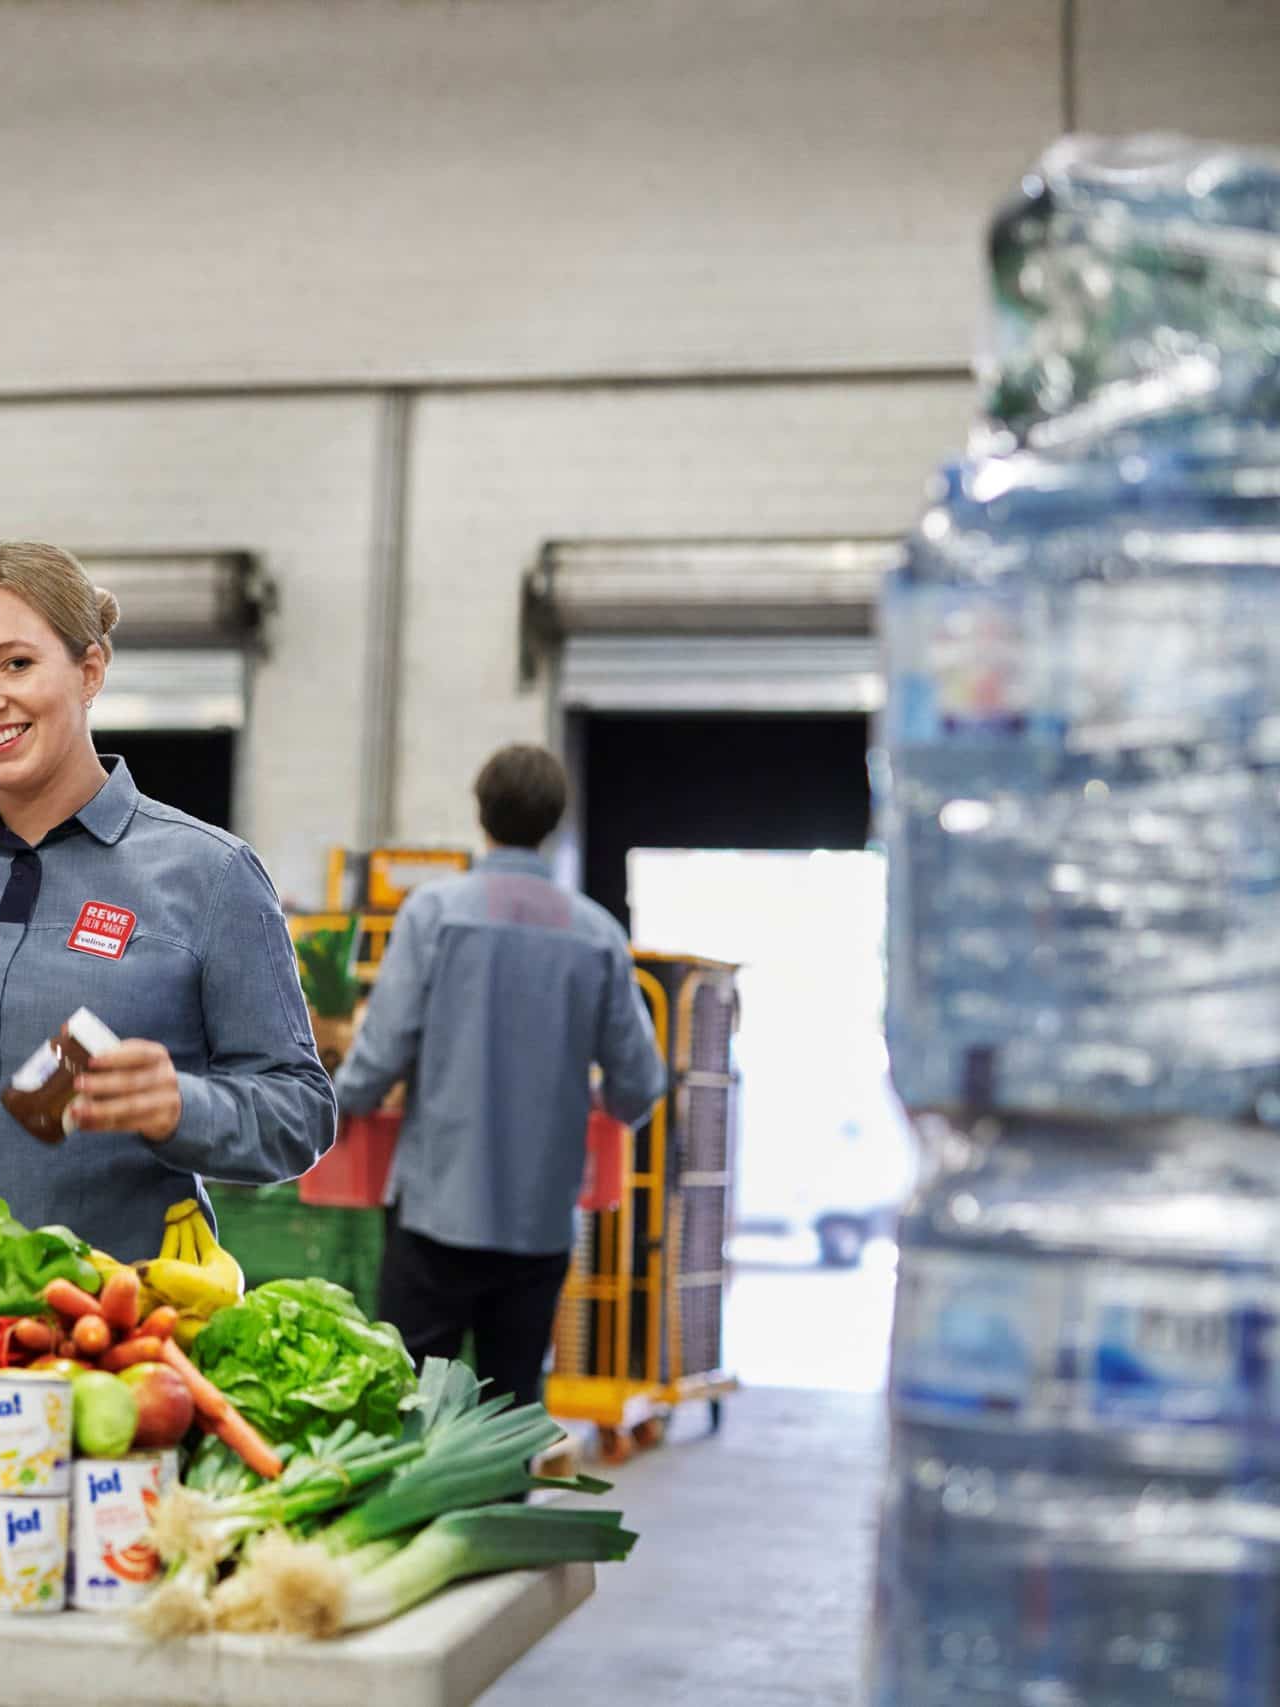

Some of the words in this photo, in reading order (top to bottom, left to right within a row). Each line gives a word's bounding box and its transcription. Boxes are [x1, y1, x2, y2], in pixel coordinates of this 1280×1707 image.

[86, 906, 130, 926] REWE
[87, 1468, 123, 1504] ja!
[6, 1508, 43, 1547] ja!
